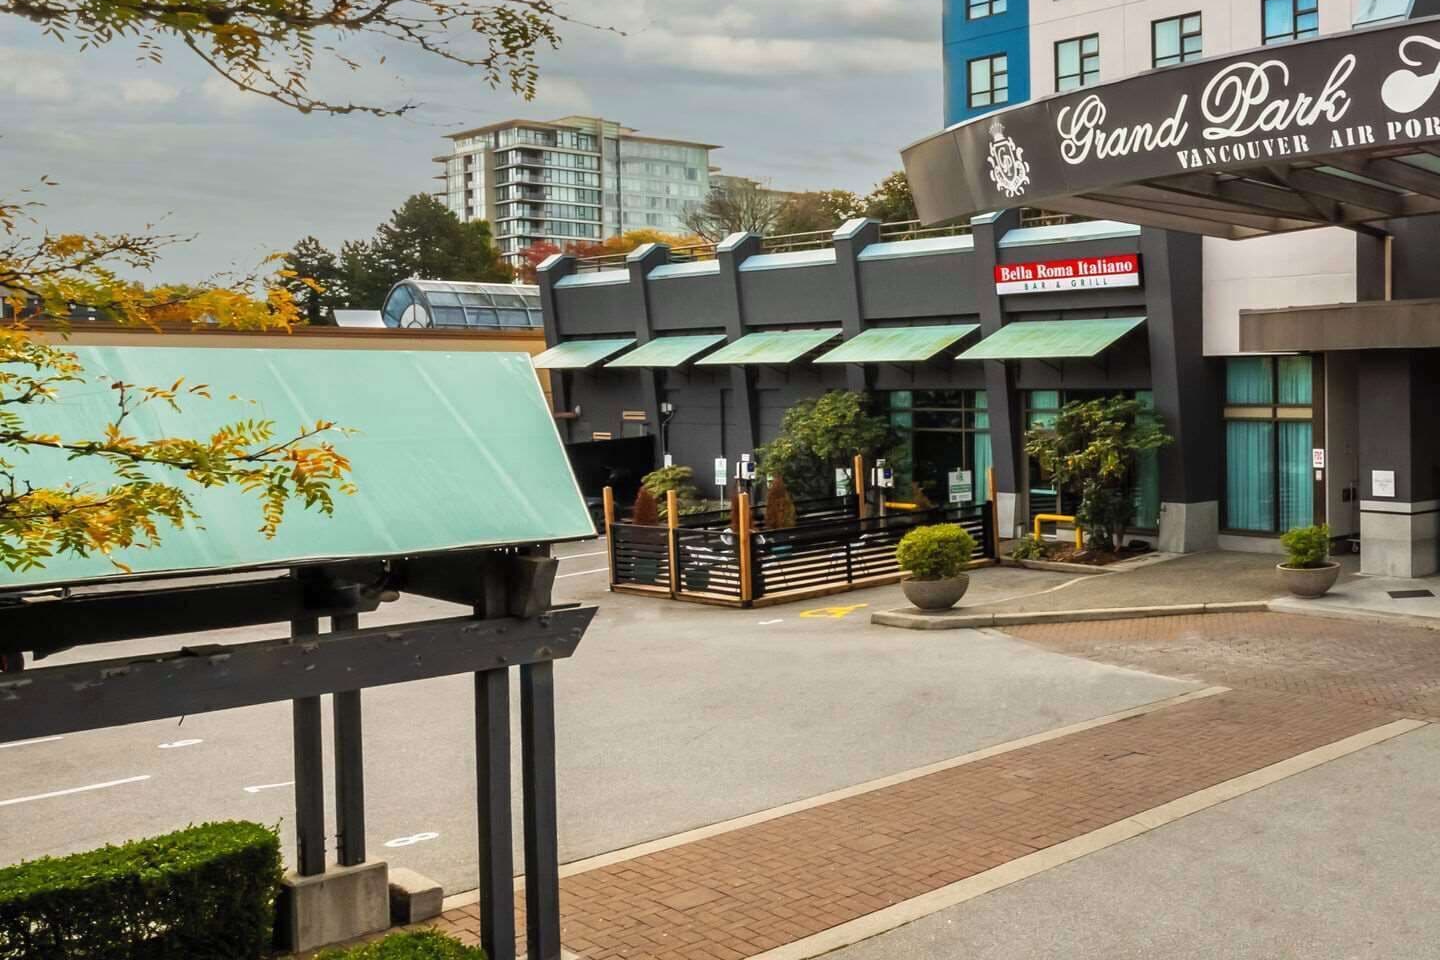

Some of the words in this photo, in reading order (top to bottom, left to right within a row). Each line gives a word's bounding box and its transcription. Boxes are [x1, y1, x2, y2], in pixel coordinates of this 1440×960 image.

[1056, 94, 1189, 165] Grand
[1201, 53, 1357, 140] Park
[1176, 134, 1311, 169] VANCOUVER
[1000, 265, 1033, 282] Bella
[1037, 263, 1073, 279] Roma
[1078, 259, 1133, 276] Italiano
[1024, 281, 1046, 290] BAR
[1071, 277, 1108, 288] GRILL
